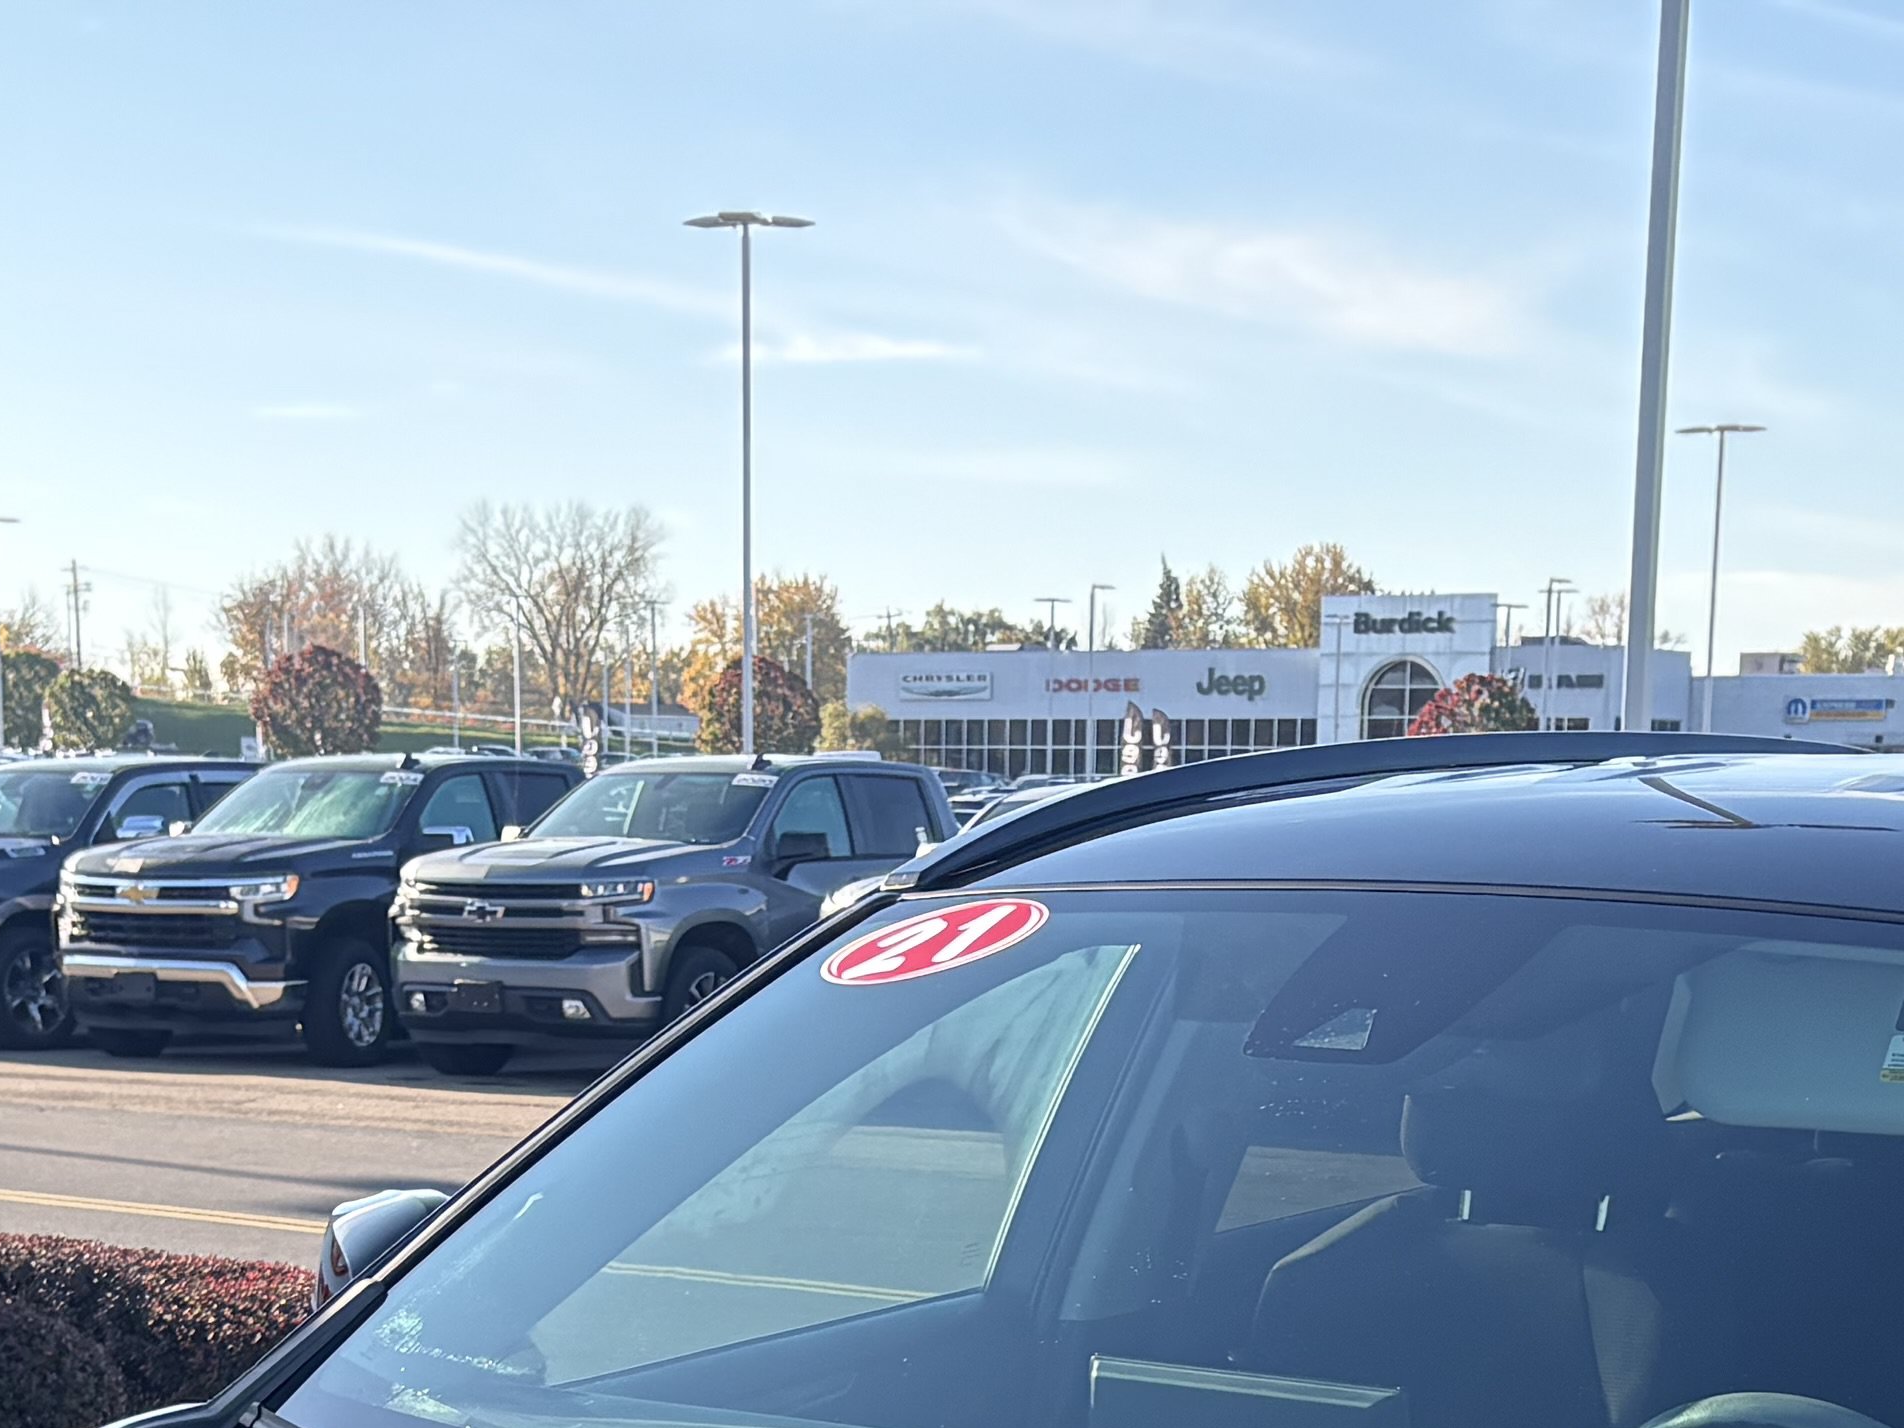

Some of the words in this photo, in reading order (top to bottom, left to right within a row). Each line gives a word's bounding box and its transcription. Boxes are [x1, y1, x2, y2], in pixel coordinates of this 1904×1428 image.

[1353, 610, 1456, 636] Burdick
[901, 673, 988, 685] CHRYSLER
[1046, 677, 1141, 693] DODGE
[1196, 667, 1266, 701] Jeep
[840, 904, 1018, 980] 21
